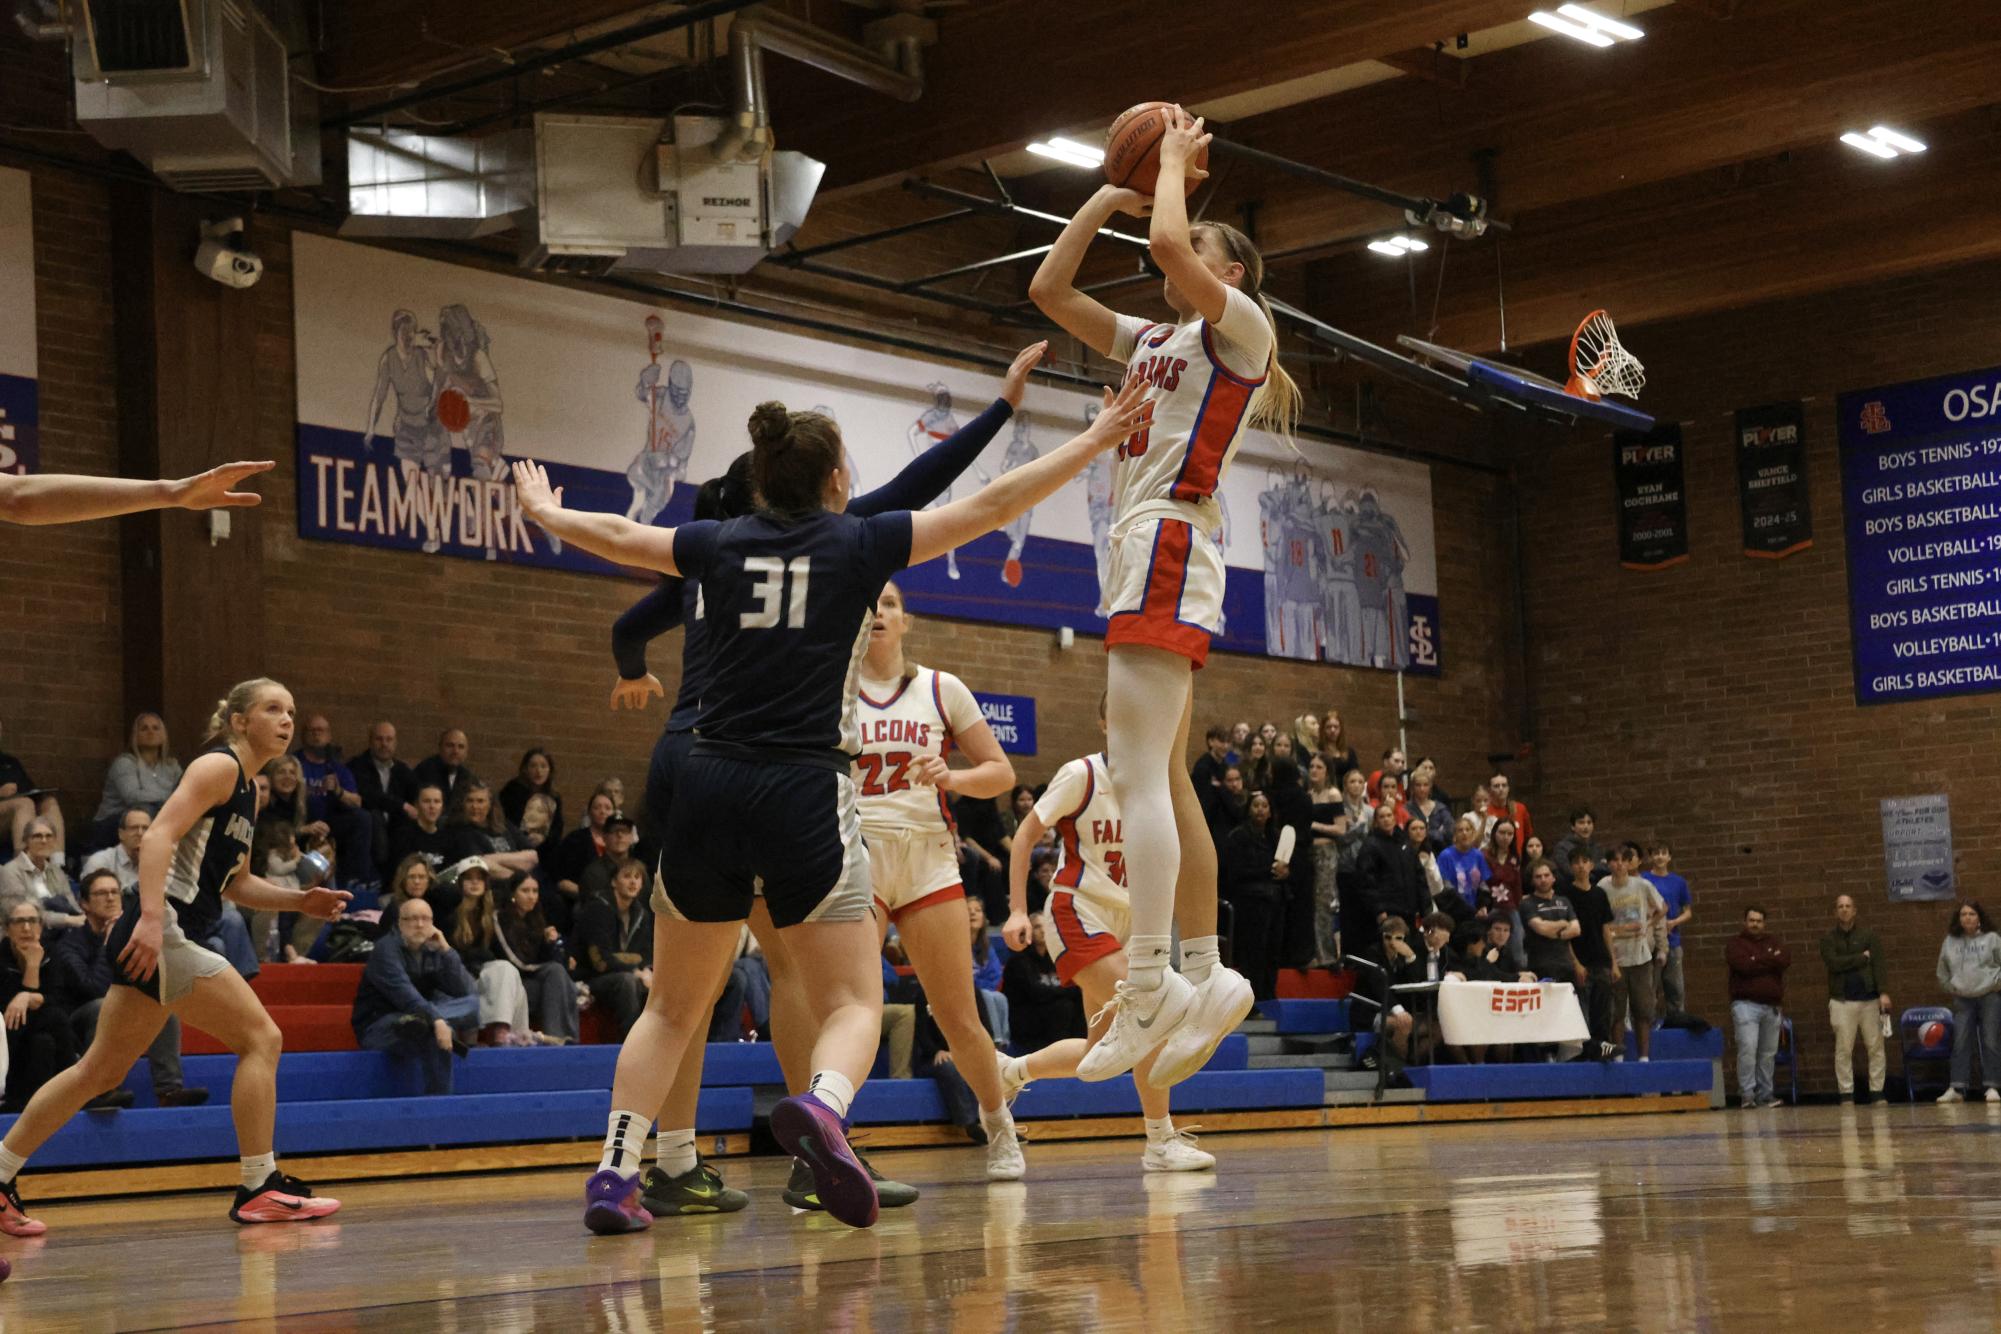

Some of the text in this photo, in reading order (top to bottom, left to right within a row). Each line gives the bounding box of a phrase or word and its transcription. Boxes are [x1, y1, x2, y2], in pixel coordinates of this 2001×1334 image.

[703, 197, 751, 207] REZNOR
[1879, 451, 1916, 470] BOYS
[310, 454, 534, 555] TEAMWORK
[1862, 484, 1903, 504] GIRLS
[1866, 515, 1903, 535] BOYS
[1888, 538, 1980, 564] VOLLEYBALL
[740, 556, 811, 629] 31
[1886, 577, 1927, 596] GIRLS
[1870, 600, 2001, 629] BOYS BASKETBALL
[1893, 633, 1985, 658] VOLLEYBALL
[1873, 664, 2001, 692] GIRLS BASKETBAL
[981, 702, 1013, 722] SALLE
[861, 719, 930, 747] LCONS
[991, 724, 1018, 743] ENTS
[857, 751, 912, 796] 22
[1092, 819, 1124, 845] FAL
[1491, 987, 1541, 1013] ESPN
